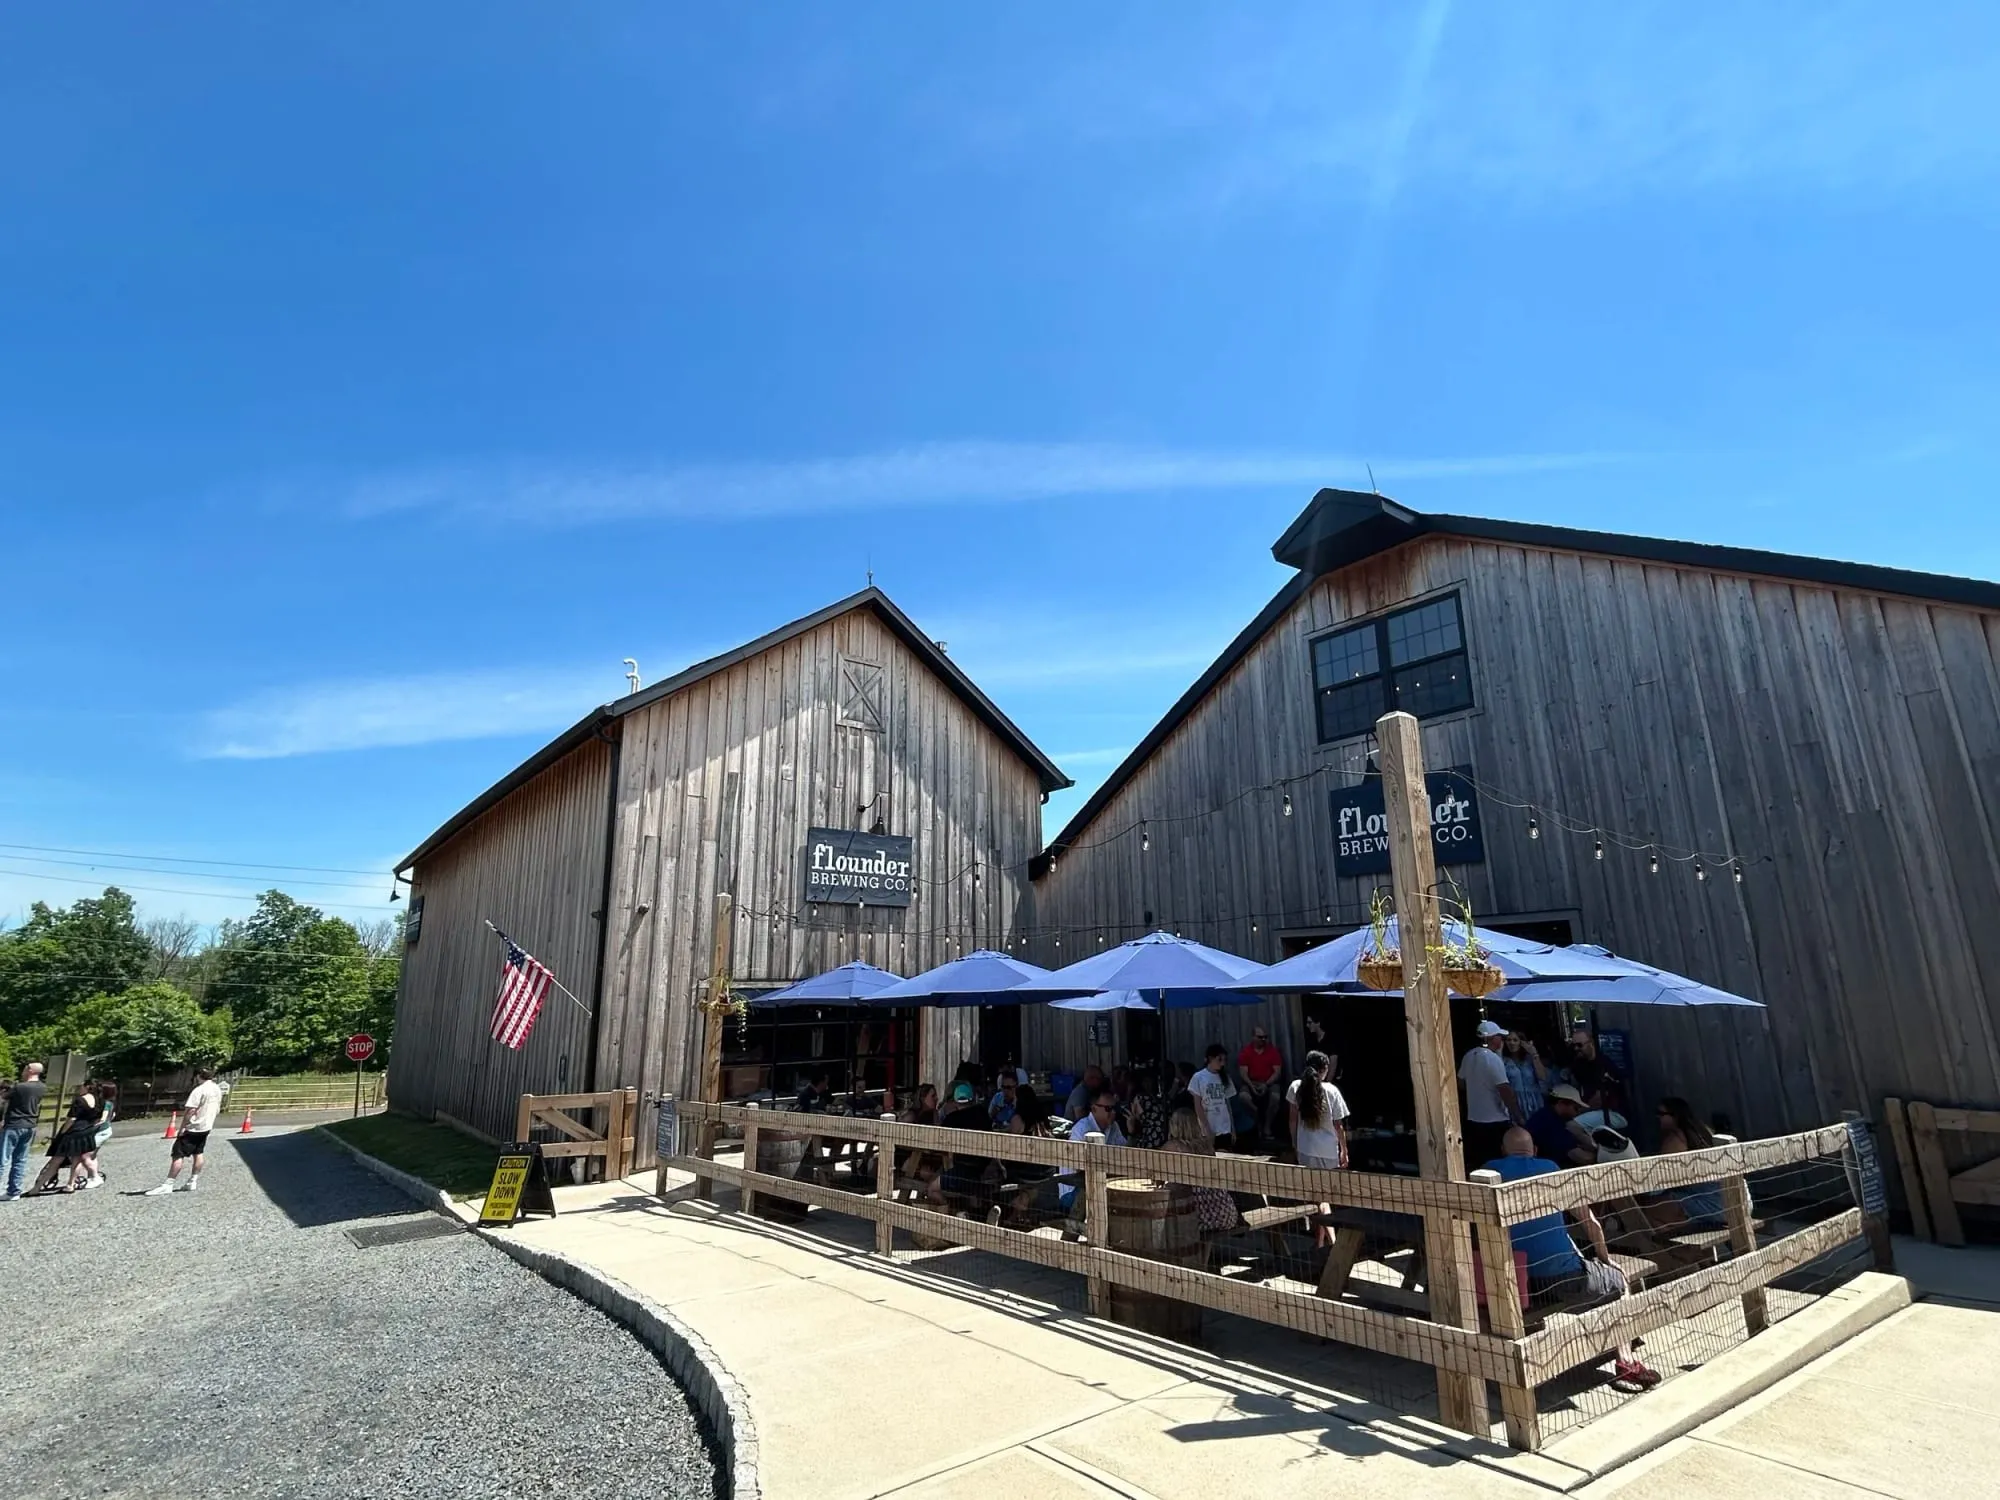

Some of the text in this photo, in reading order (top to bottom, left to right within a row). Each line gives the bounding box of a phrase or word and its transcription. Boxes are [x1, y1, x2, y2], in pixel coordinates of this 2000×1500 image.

[1435, 825, 1473, 843] CO.
[811, 844, 909, 877] flounder
[811, 872, 909, 891] BREWING CO.
[348, 1042, 373, 1053] STOP
[498, 1172, 521, 1185] SLOW
[494, 1186, 516, 1199] DOWN
